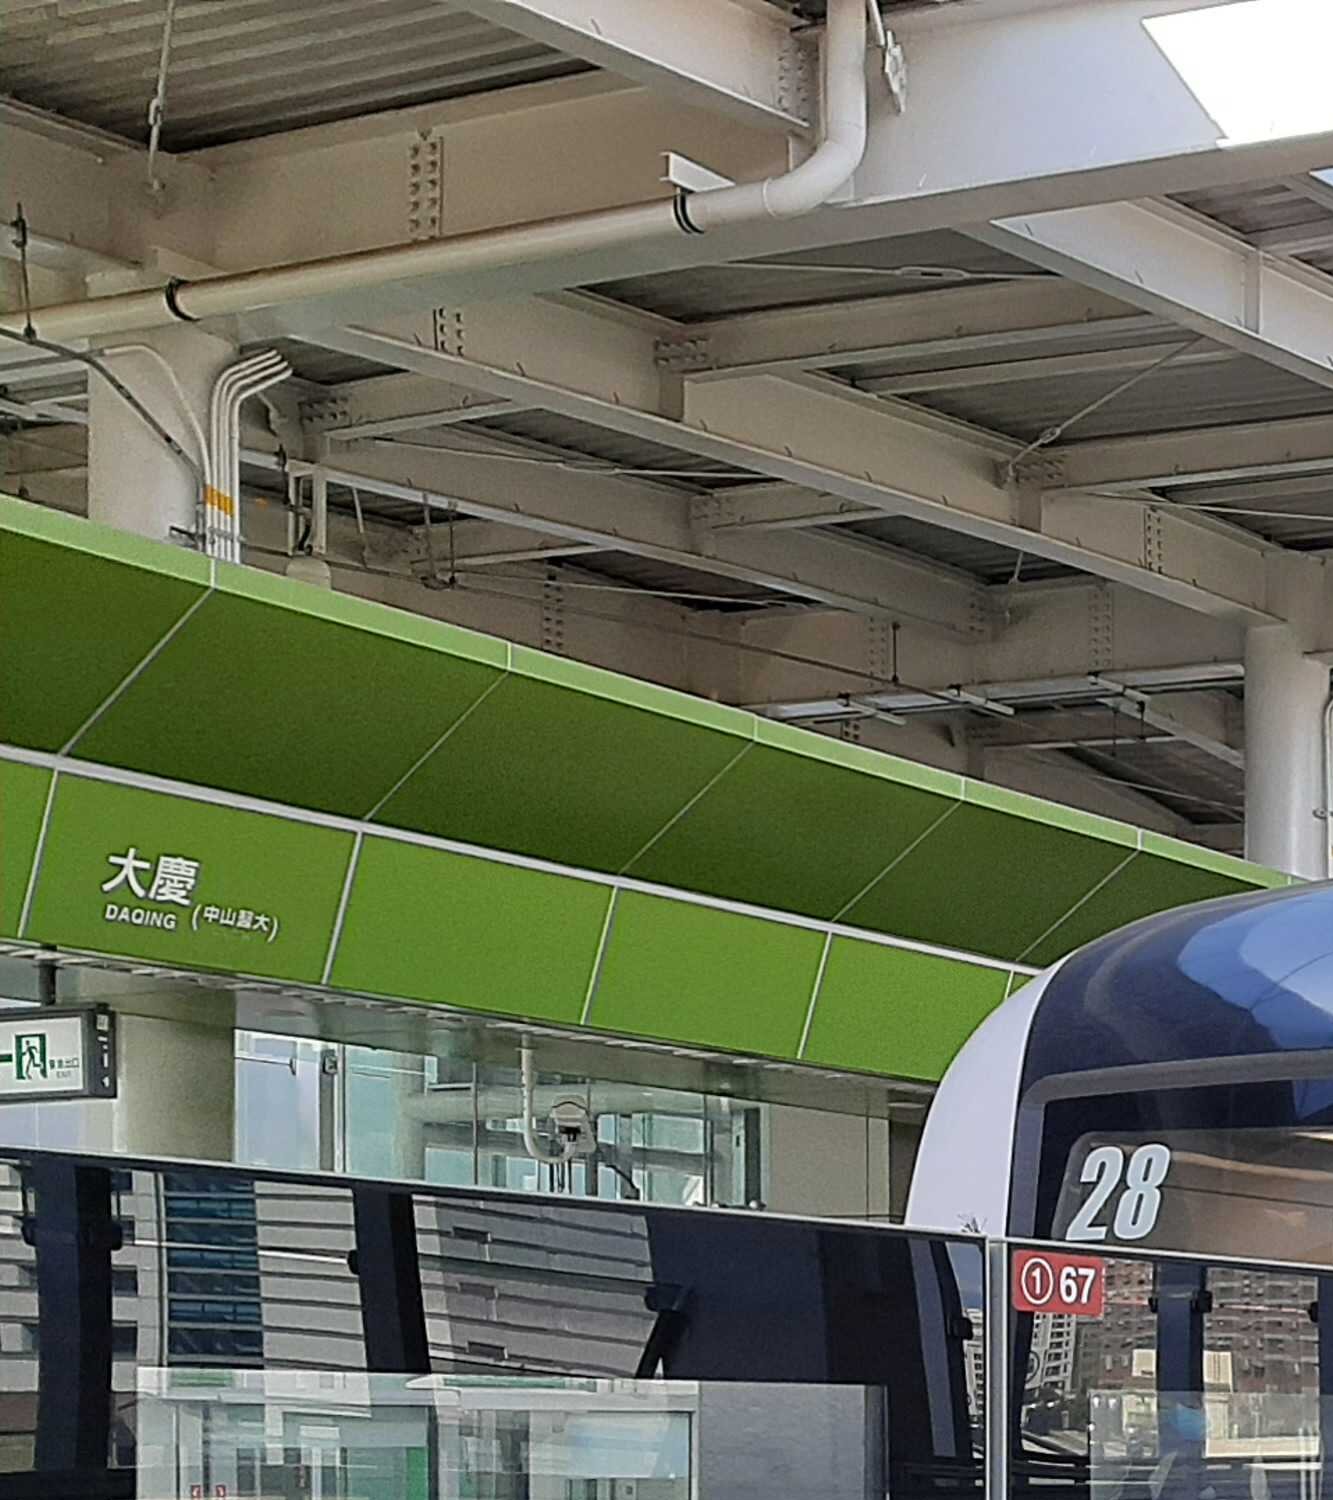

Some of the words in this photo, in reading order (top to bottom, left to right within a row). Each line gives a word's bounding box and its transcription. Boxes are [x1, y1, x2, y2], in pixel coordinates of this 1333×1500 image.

[101, 847, 200, 906] 大慶
[105, 904, 177, 929] DAQING
[1065, 1143, 1171, 1241] 28
[1059, 1266, 1096, 1304] 67
